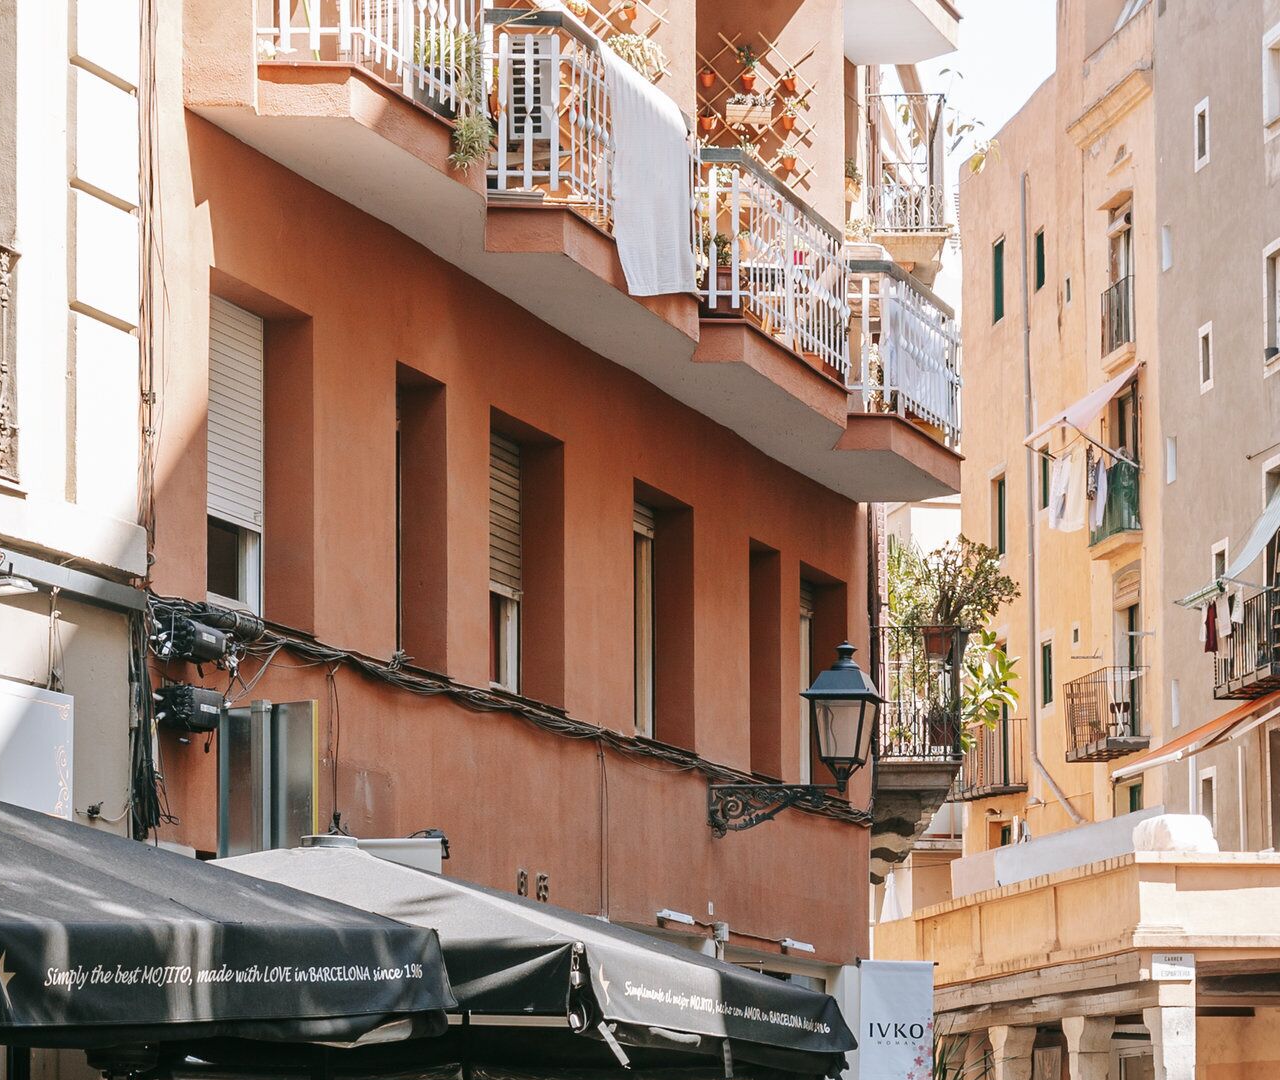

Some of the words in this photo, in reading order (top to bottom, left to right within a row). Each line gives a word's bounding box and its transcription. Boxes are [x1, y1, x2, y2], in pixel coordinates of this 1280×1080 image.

[44, 965, 88, 992] Simply
[91, 964, 113, 984] the
[115, 964, 141, 984] best
[142, 965, 193, 987] MOJITO,
[197, 963, 234, 983] made
[236, 965, 263, 983] with
[263, 965, 292, 983] LOVE
[294, 967, 308, 982] in
[308, 965, 371, 982] BARCELONA
[373, 966, 404, 981] since
[869, 1022, 924, 1039] IVKO
